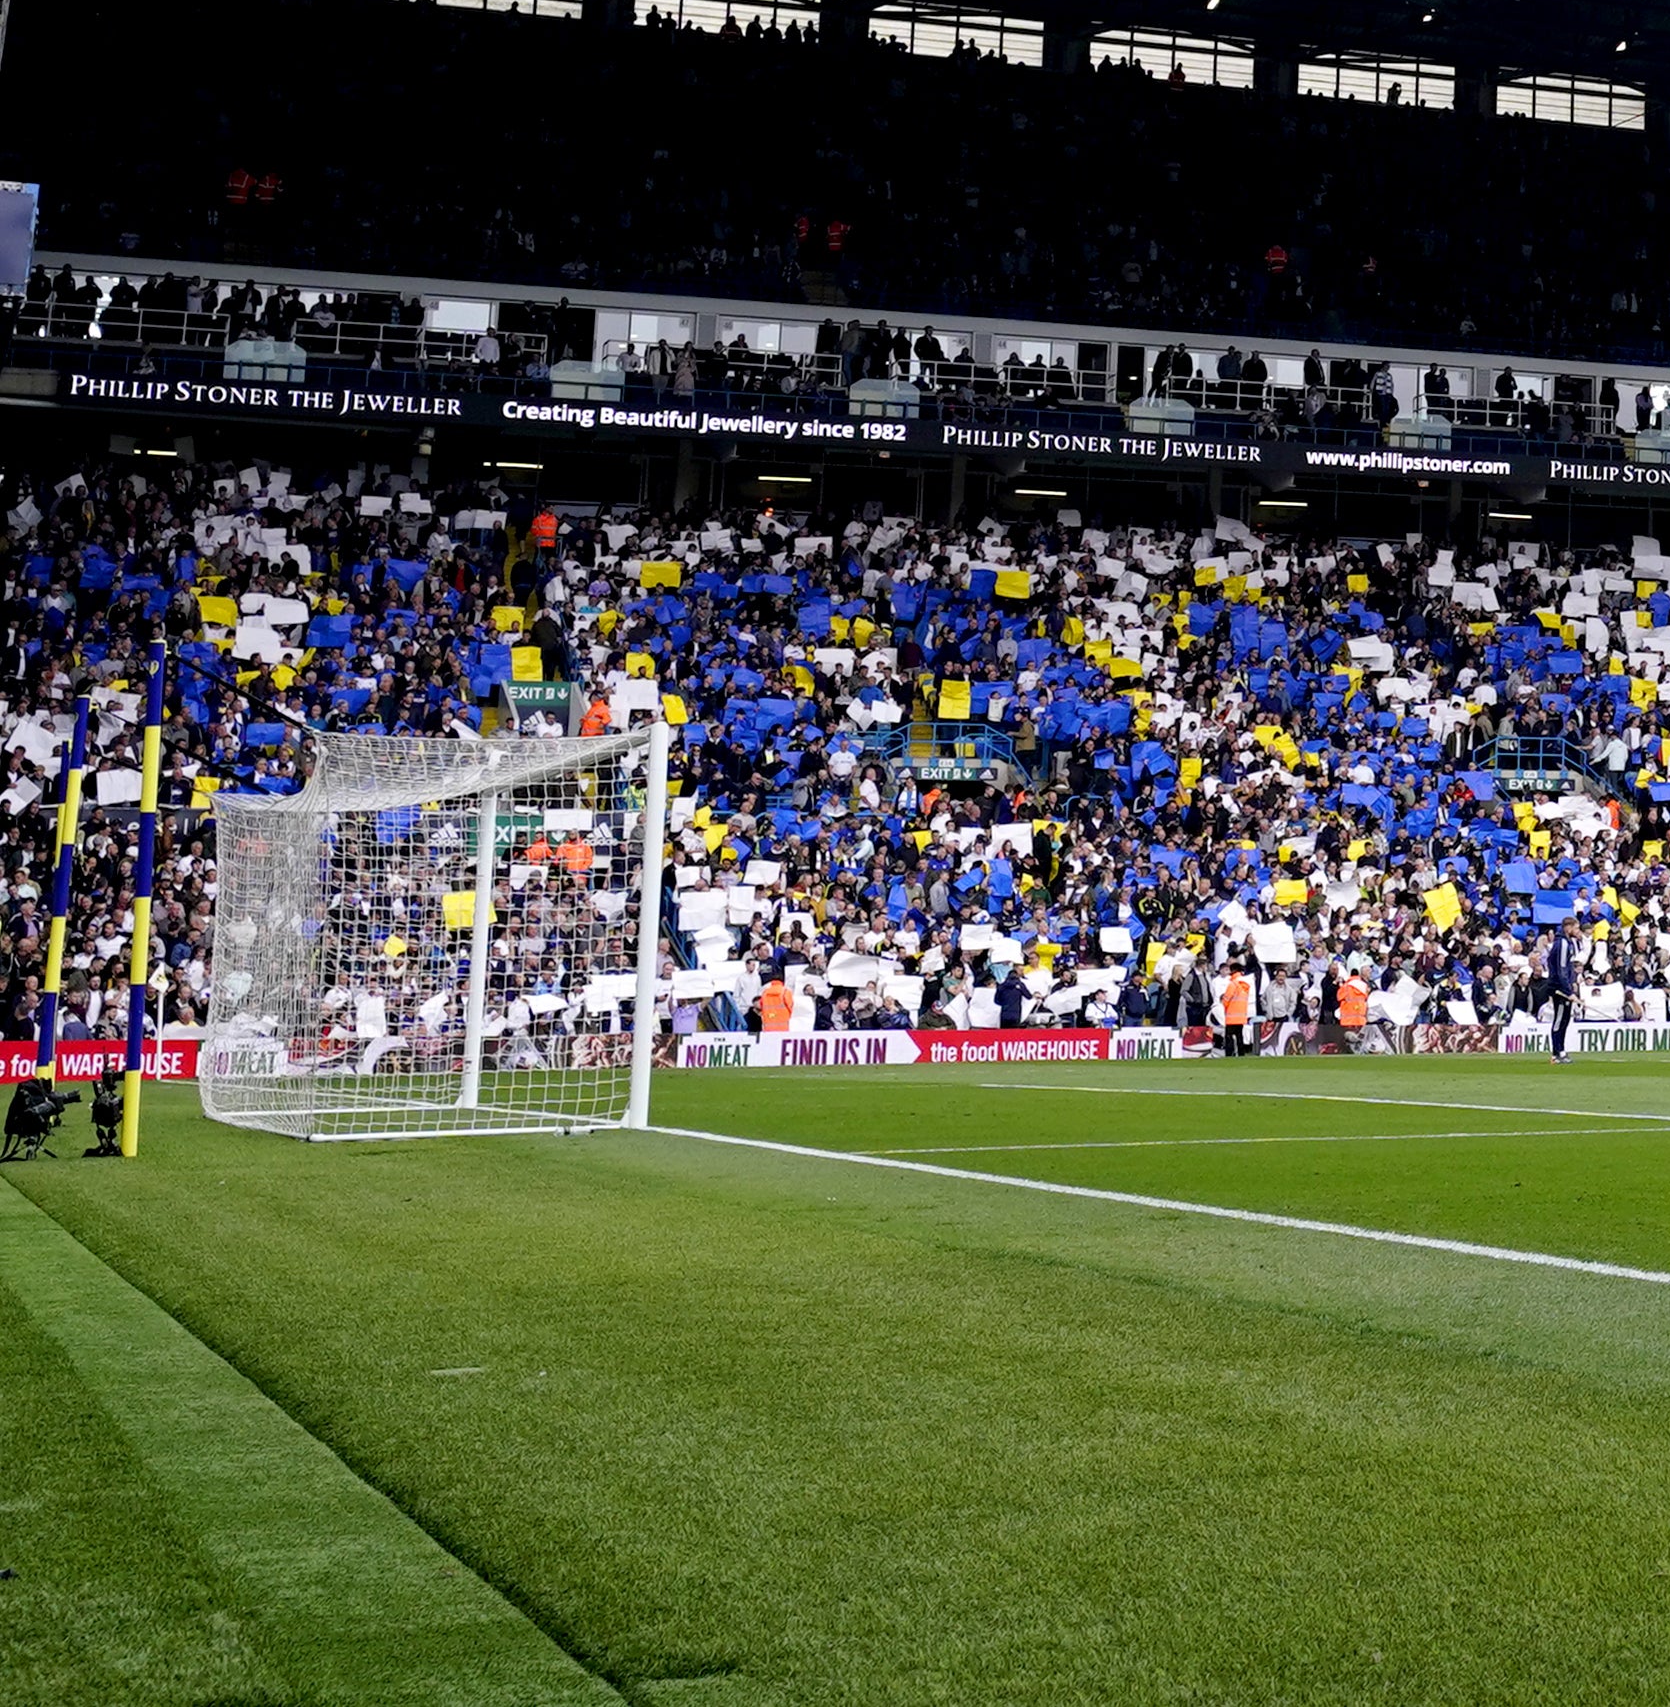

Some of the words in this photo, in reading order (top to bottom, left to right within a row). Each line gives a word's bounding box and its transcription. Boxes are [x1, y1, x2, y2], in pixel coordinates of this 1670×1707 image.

[70, 374, 169, 400] PHILLIP
[174, 381, 278, 406] STONER
[287, 390, 334, 409] THE
[339, 389, 461, 416] JEWELLER
[502, 401, 595, 428] Creating
[599, 407, 697, 430] Beautiful
[698, 413, 799, 440] Jewellery
[802, 419, 855, 439] since
[860, 422, 906, 441] 1982
[943, 425, 1023, 448] PHILLIP
[1027, 430, 1112, 453] STONER
[1118, 438, 1157, 456] THE
[1161, 438, 1261, 462] JEWELLER
[1305, 451, 1511, 475] www.phillipstoner.com
[1550, 460, 1620, 481] PHILLIP
[509, 686, 543, 700] EXIT
[921, 768, 950, 779] EXIT
[780, 1038, 827, 1066] FIND
[834, 1038, 860, 1065] US
[866, 1037, 887, 1064] IN
[931, 1042, 957, 1063] the
[961, 1040, 998, 1062] food
[1001, 1039, 1100, 1061] WAREHOUSE
[1578, 1029, 1610, 1052] TRY
[1613, 1028, 1647, 1052] OUR
